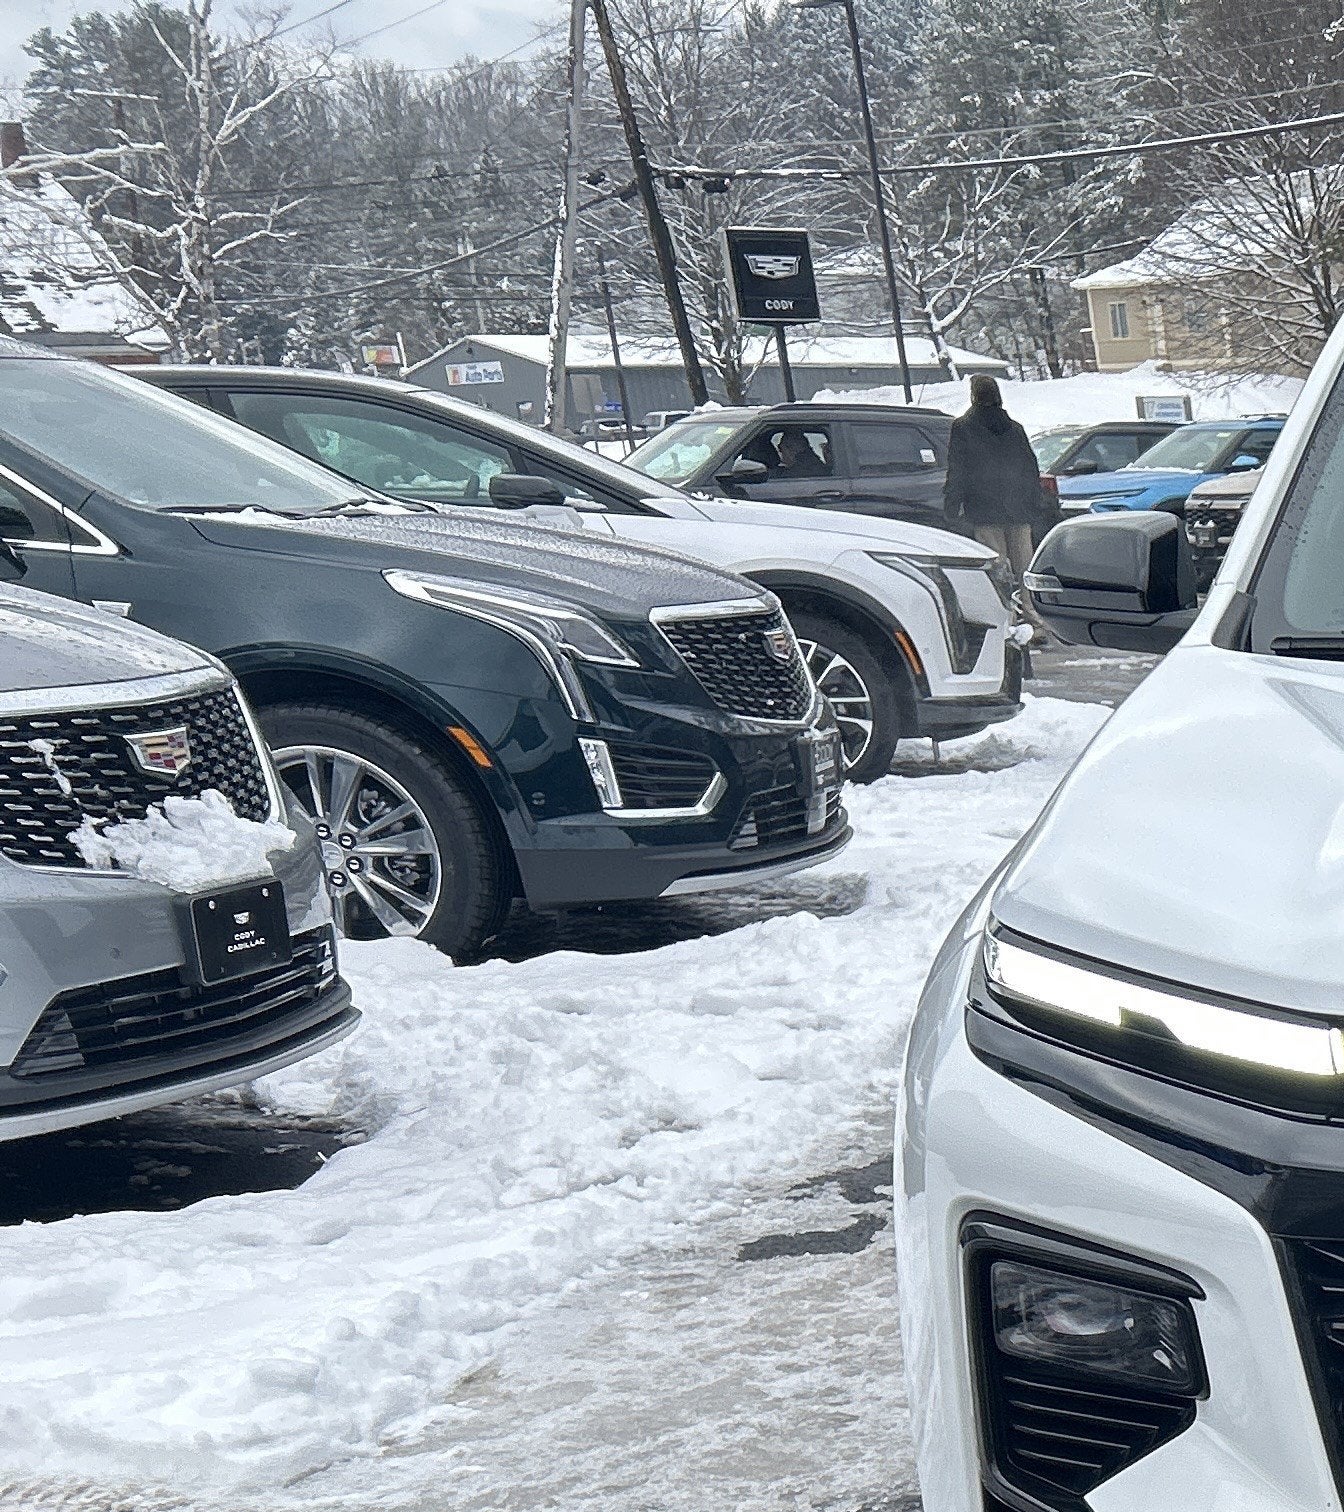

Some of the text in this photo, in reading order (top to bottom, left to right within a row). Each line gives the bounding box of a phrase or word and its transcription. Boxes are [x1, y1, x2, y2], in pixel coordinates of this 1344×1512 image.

[764, 299, 795, 311] CODY
[233, 929, 256, 941] CODY
[227, 937, 266, 953] CADILLAC
